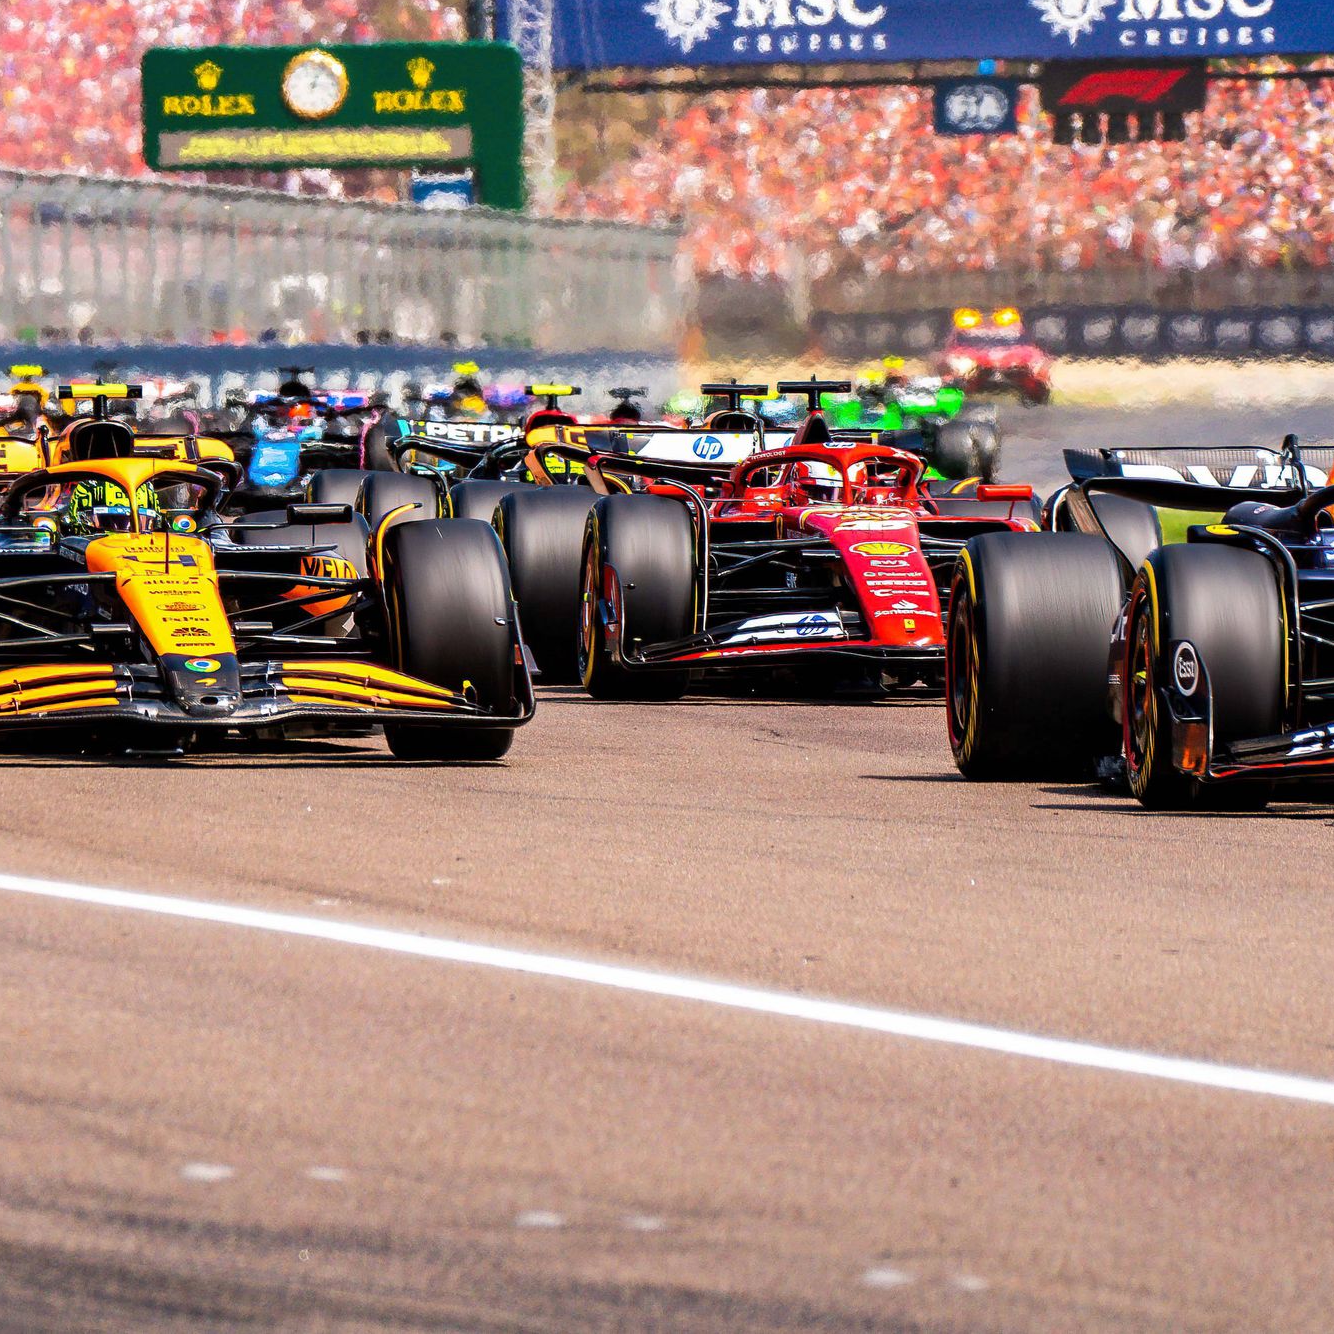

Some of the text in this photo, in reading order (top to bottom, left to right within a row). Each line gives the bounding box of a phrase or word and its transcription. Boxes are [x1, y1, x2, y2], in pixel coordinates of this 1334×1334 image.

[1118, 26, 1275, 46] CRUISES
[163, 94, 255, 116] ROLEX
[373, 89, 466, 114] ROLEX
[426, 422, 525, 443] PETR
[694, 435, 723, 460] hp
[874, 608, 938, 618] Santander
